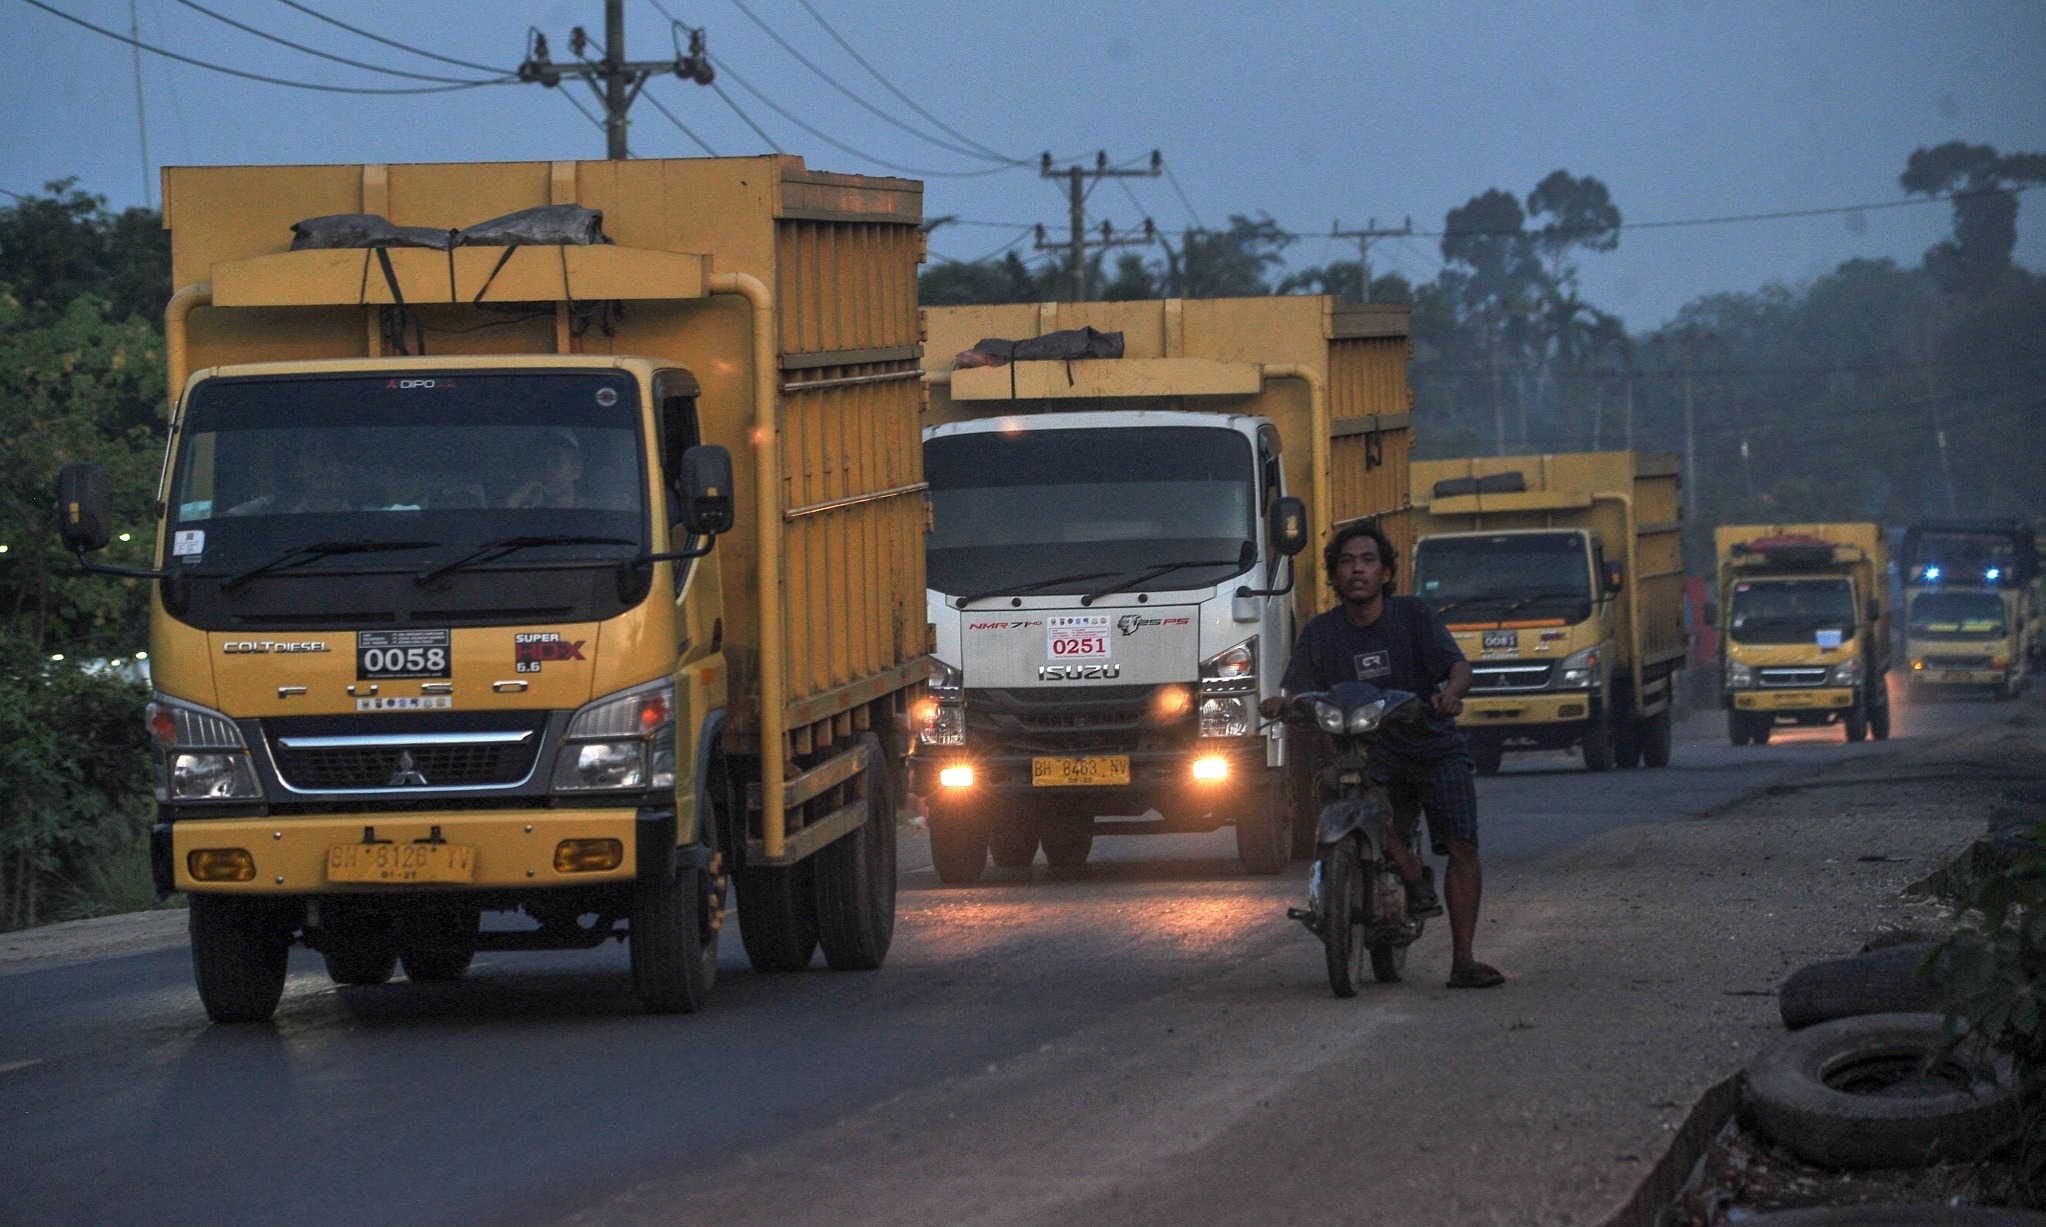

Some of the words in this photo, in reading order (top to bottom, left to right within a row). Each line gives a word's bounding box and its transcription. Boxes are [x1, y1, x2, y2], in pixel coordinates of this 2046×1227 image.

[400, 380, 435, 389] DIPO
[969, 622, 1009, 630] NMR
[1163, 618, 1189, 626] PS
[516, 633, 559, 643] SUPER
[223, 641, 274, 654] COLT
[274, 641, 331, 653] DIESEL
[1053, 637, 1106, 655] 0251
[364, 648, 446, 672] 0058
[516, 662, 541, 673] 6.6
[1038, 664, 1120, 681] ISUZU
[278, 680, 528, 699] FUSO
[1034, 760, 1051, 777] BH
[1063, 759, 1097, 776] 8463
